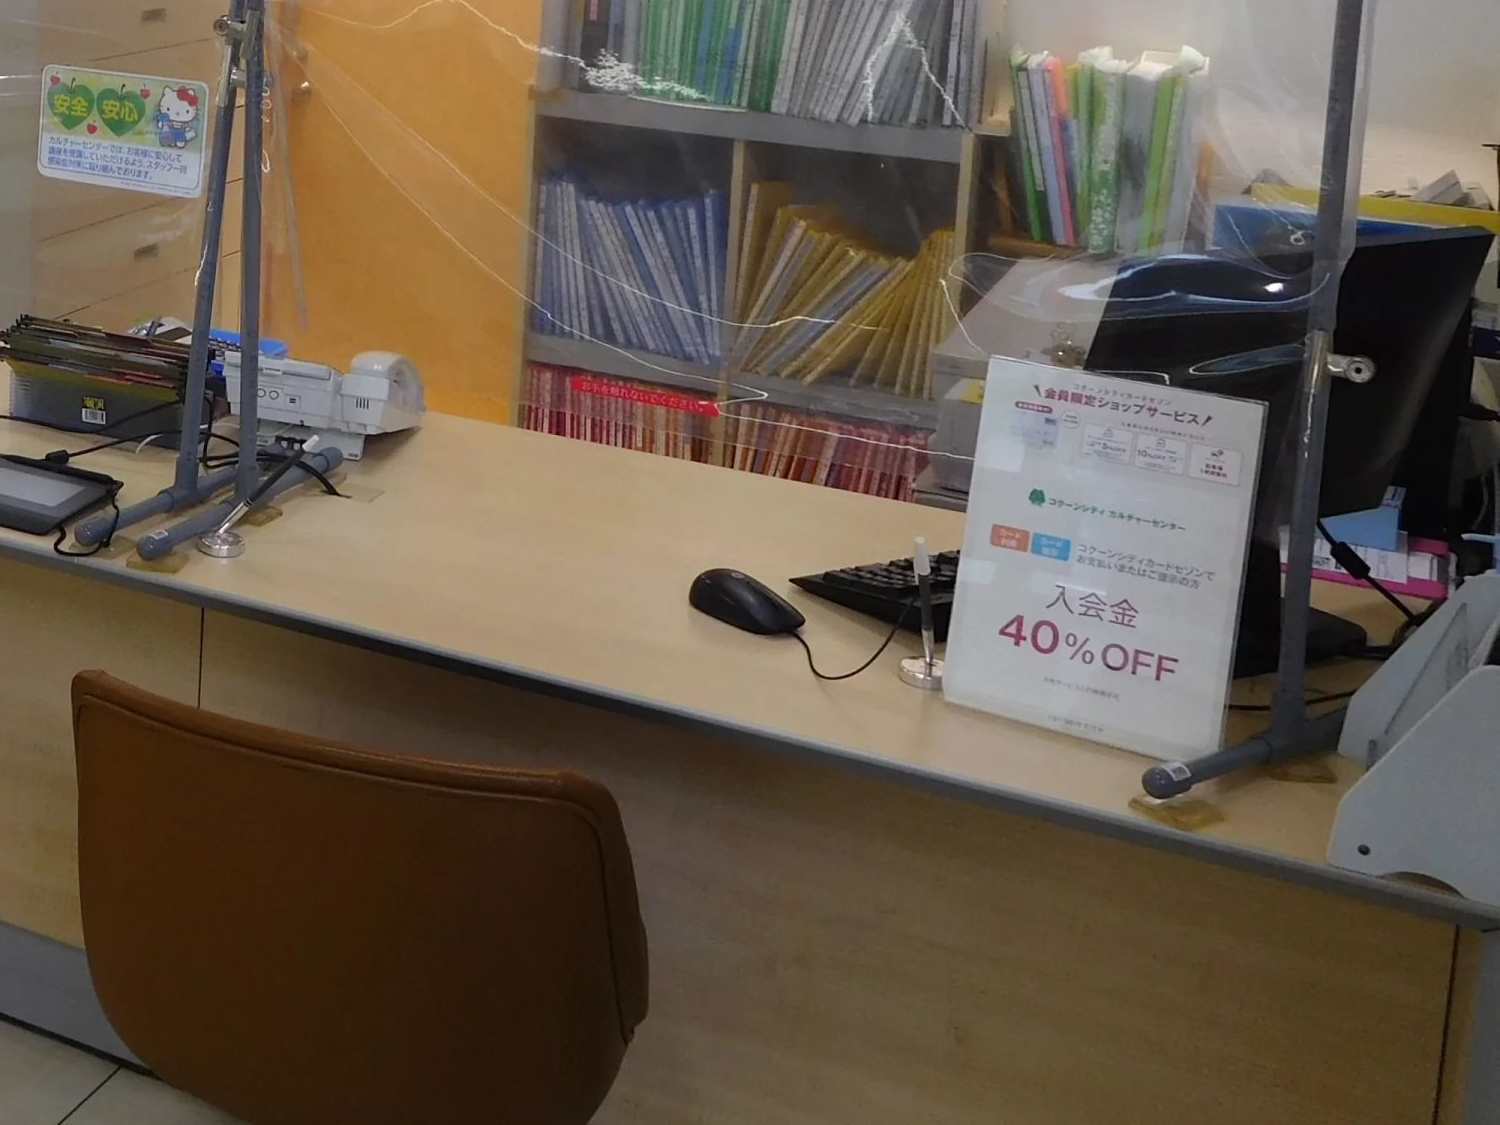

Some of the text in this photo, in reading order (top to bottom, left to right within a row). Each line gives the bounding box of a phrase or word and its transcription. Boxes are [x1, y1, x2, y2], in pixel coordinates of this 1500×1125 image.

[53, 93, 90, 118] 安全
[101, 100, 139, 122] 安心
[1043, 386, 1203, 426] 会員限定ショップサービス
[1045, 583, 1140, 629] 入会金
[998, 613, 1180, 682] 40%OFF
